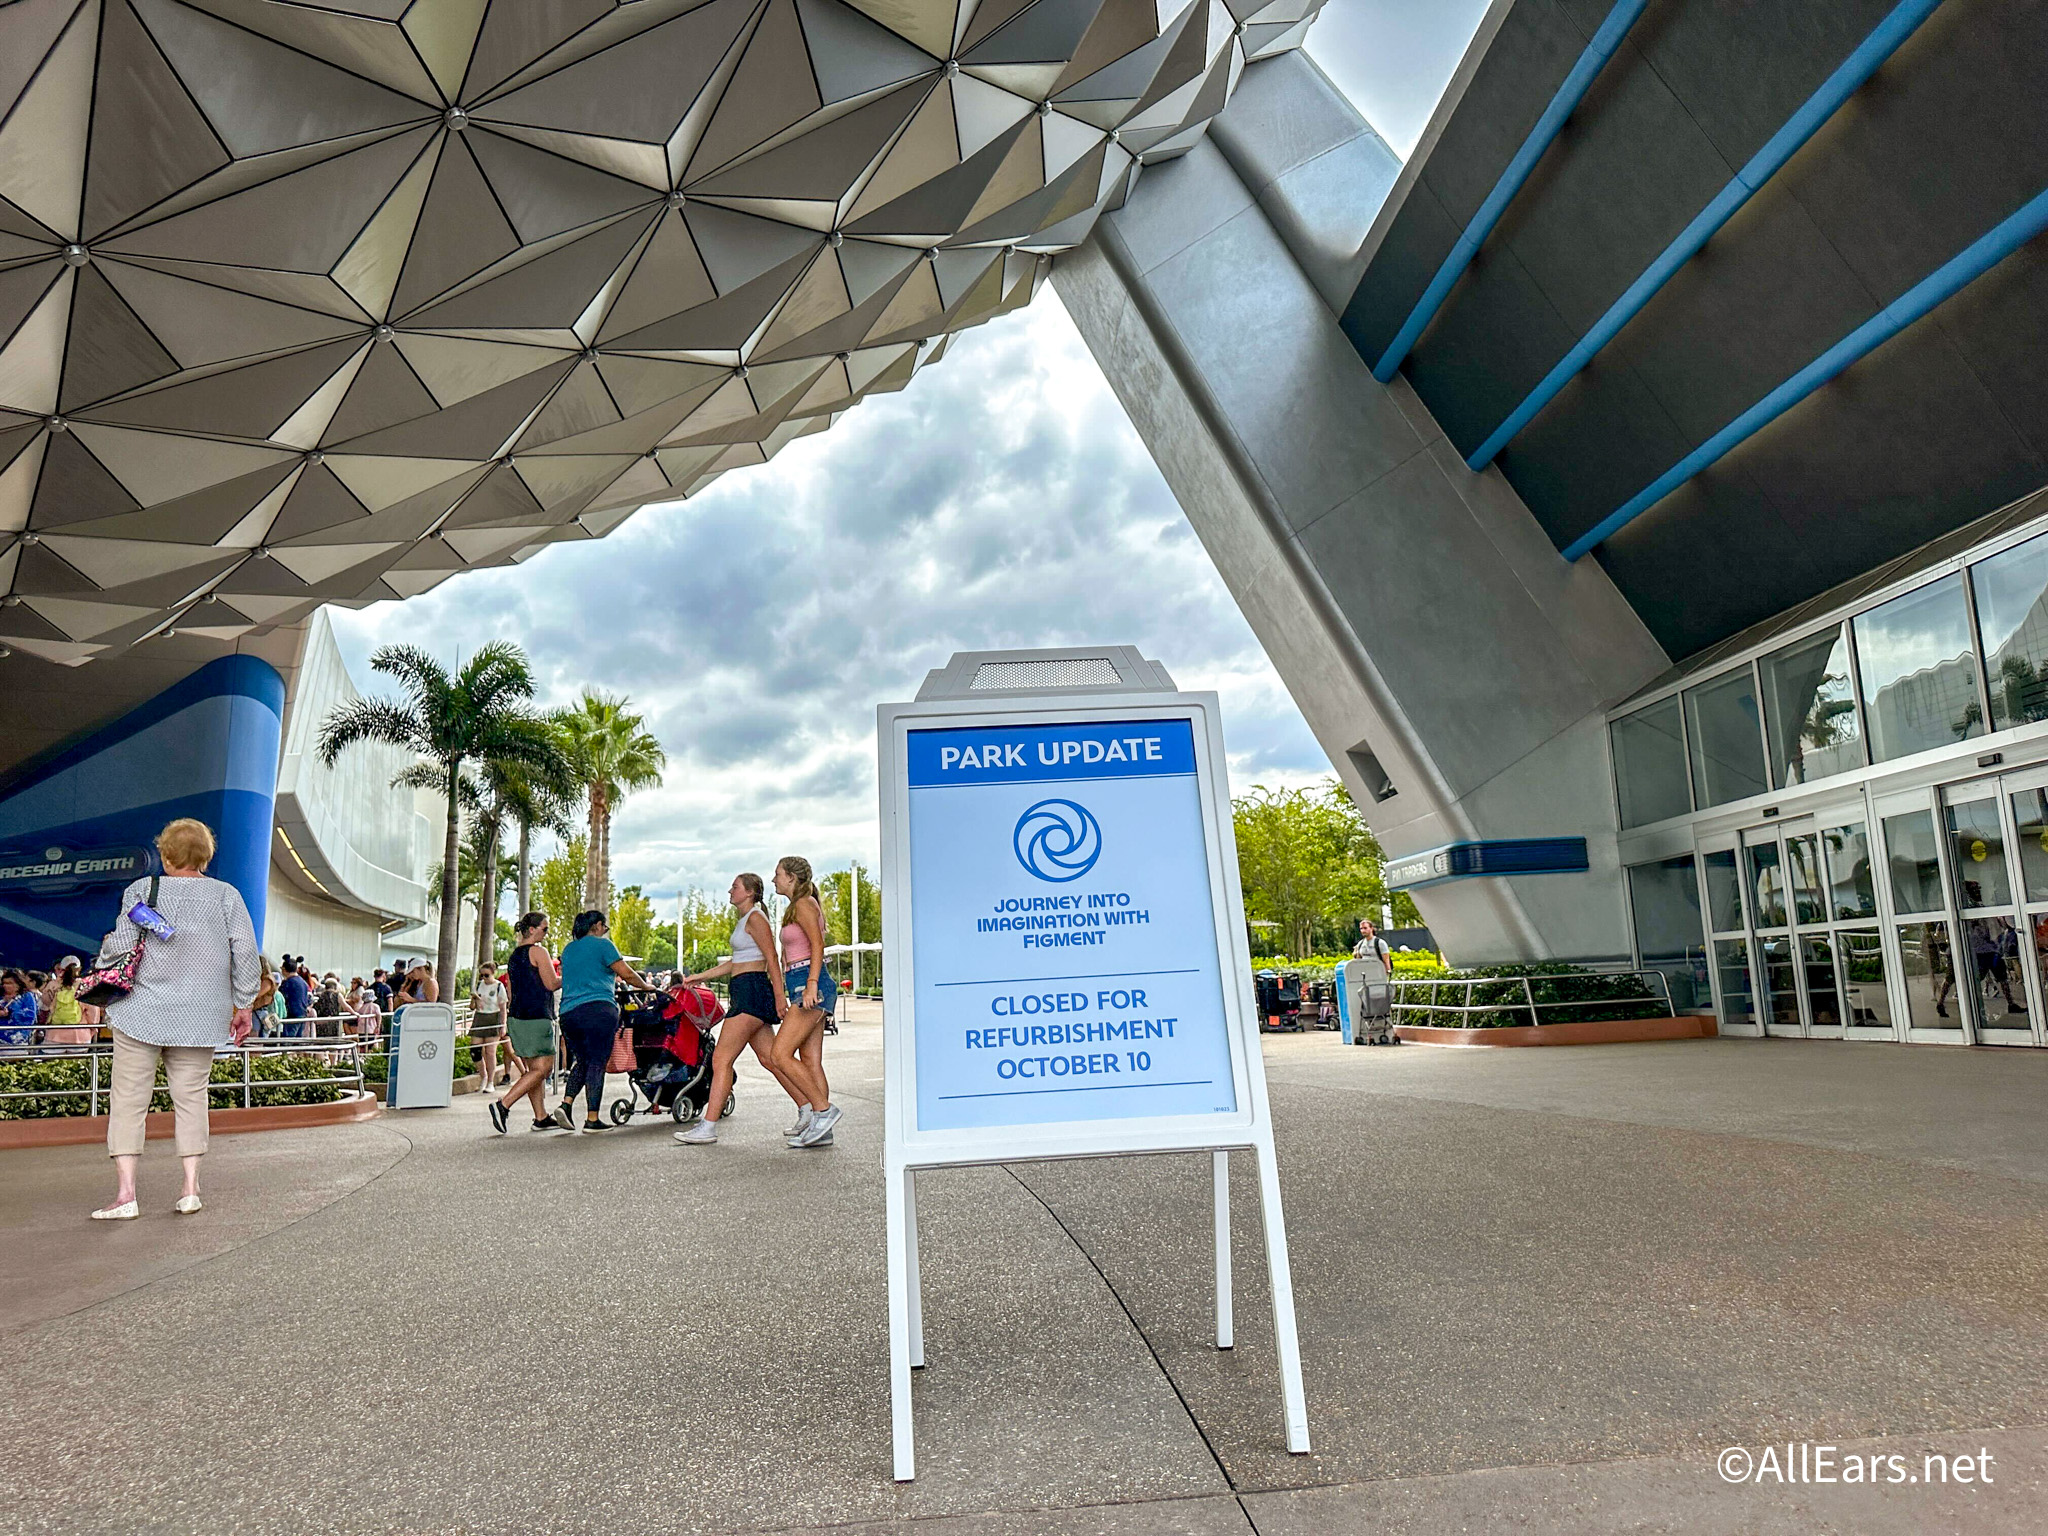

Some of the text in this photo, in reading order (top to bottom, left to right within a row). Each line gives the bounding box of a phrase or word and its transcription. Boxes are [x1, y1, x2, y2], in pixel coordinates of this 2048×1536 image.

[941, 737, 1163, 770] PARK UPDATE
[74, 857, 135, 874] EARTH
[994, 893, 1131, 913] JOURNEY INTO
[977, 910, 1150, 932] IMAGINATION WITH
[1023, 930, 1106, 949] FIGMENT
[991, 989, 1149, 1016] CLOSED FOR
[965, 1018, 1178, 1049] REFURBISHMENT
[996, 1051, 1151, 1079] OCTOBER 10
